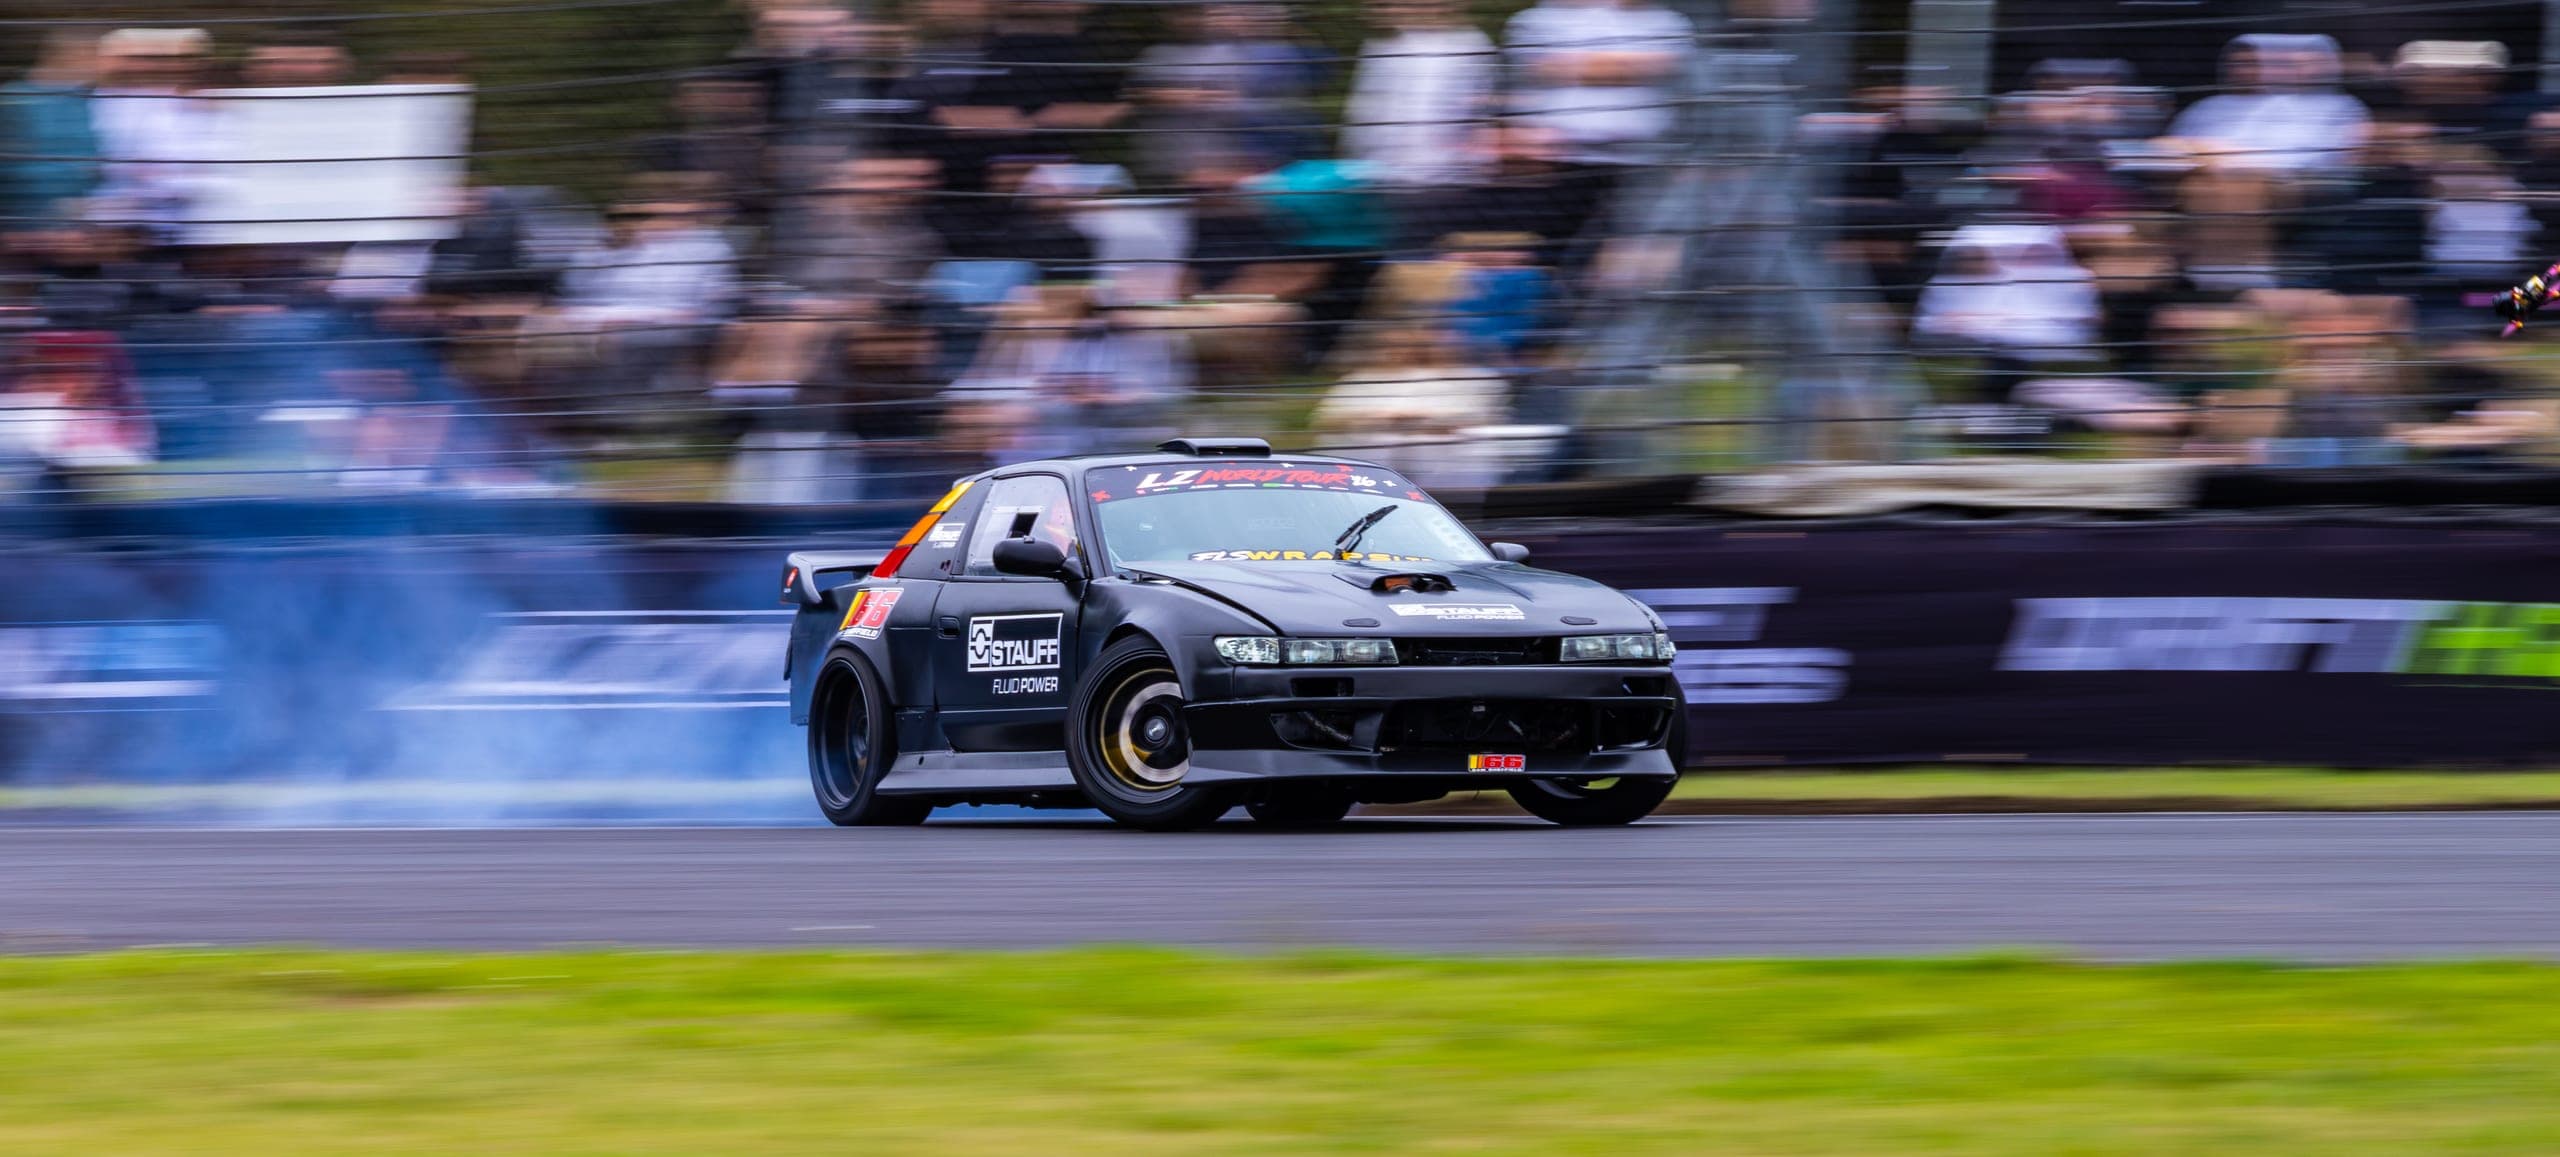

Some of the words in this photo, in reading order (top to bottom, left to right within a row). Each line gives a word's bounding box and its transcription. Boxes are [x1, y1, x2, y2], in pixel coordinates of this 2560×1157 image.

[1136, 470, 1202, 489] LZ
[1284, 470, 1351, 485] TOUR
[992, 639, 1058, 665] STAUFF
[993, 678, 1020, 694] FLUID
[1020, 676, 1058, 693] POWER
[1484, 755, 1523, 769] 66
